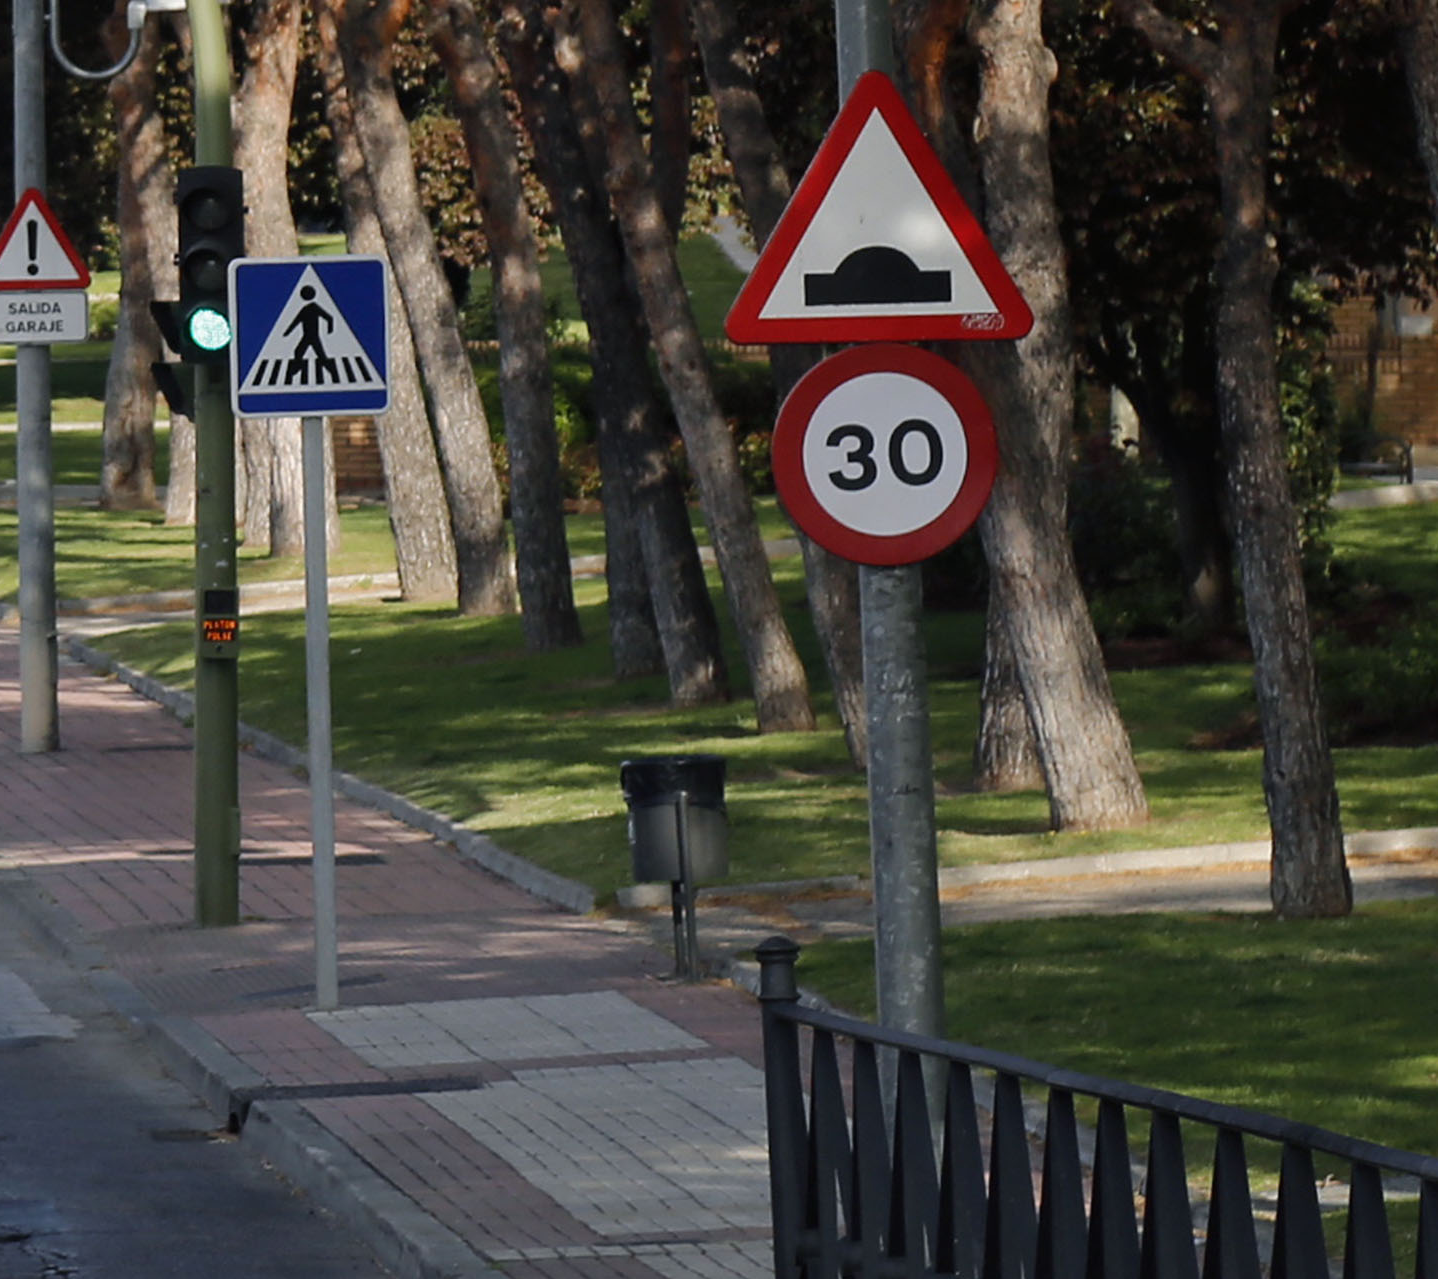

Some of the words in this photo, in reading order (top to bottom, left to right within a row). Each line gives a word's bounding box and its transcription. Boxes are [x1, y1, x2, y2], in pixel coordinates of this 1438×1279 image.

[8, 302, 61, 315] SALIDA
[5, 320, 64, 333] GARAJE
[826, 419, 943, 492] 30
